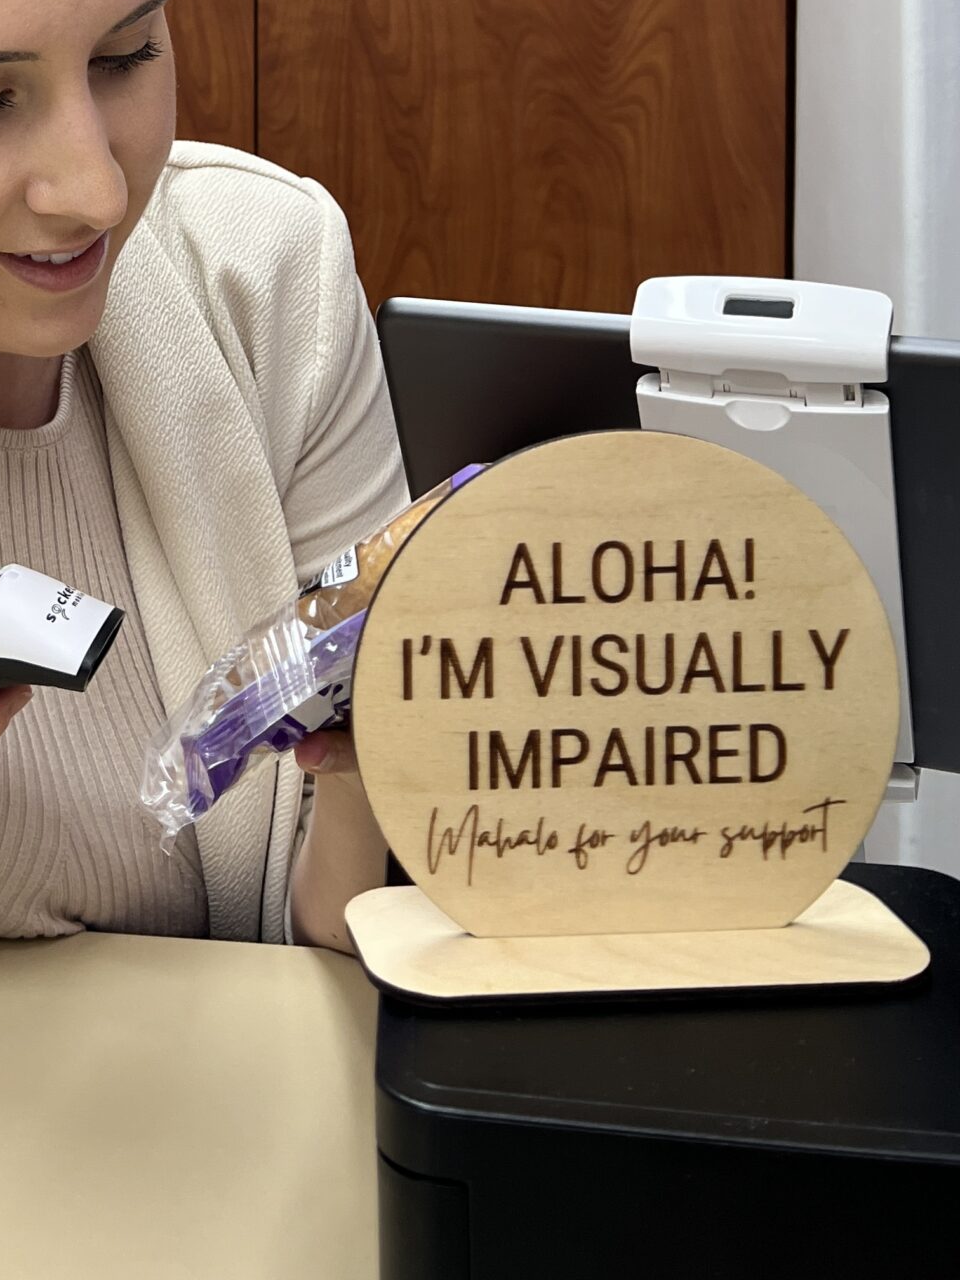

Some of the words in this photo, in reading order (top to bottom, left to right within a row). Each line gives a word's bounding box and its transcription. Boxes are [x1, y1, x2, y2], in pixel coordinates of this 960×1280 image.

[499, 538, 756, 605] ALOHA!
[401, 634, 495, 701] I'M
[521, 628, 851, 698] VISUALLY
[467, 723, 788, 791] IMPAIRED
[426, 803, 560, 887] Mahalo
[567, 822, 616, 871] for
[626, 820, 707, 876] your
[719, 796, 847, 862] support
